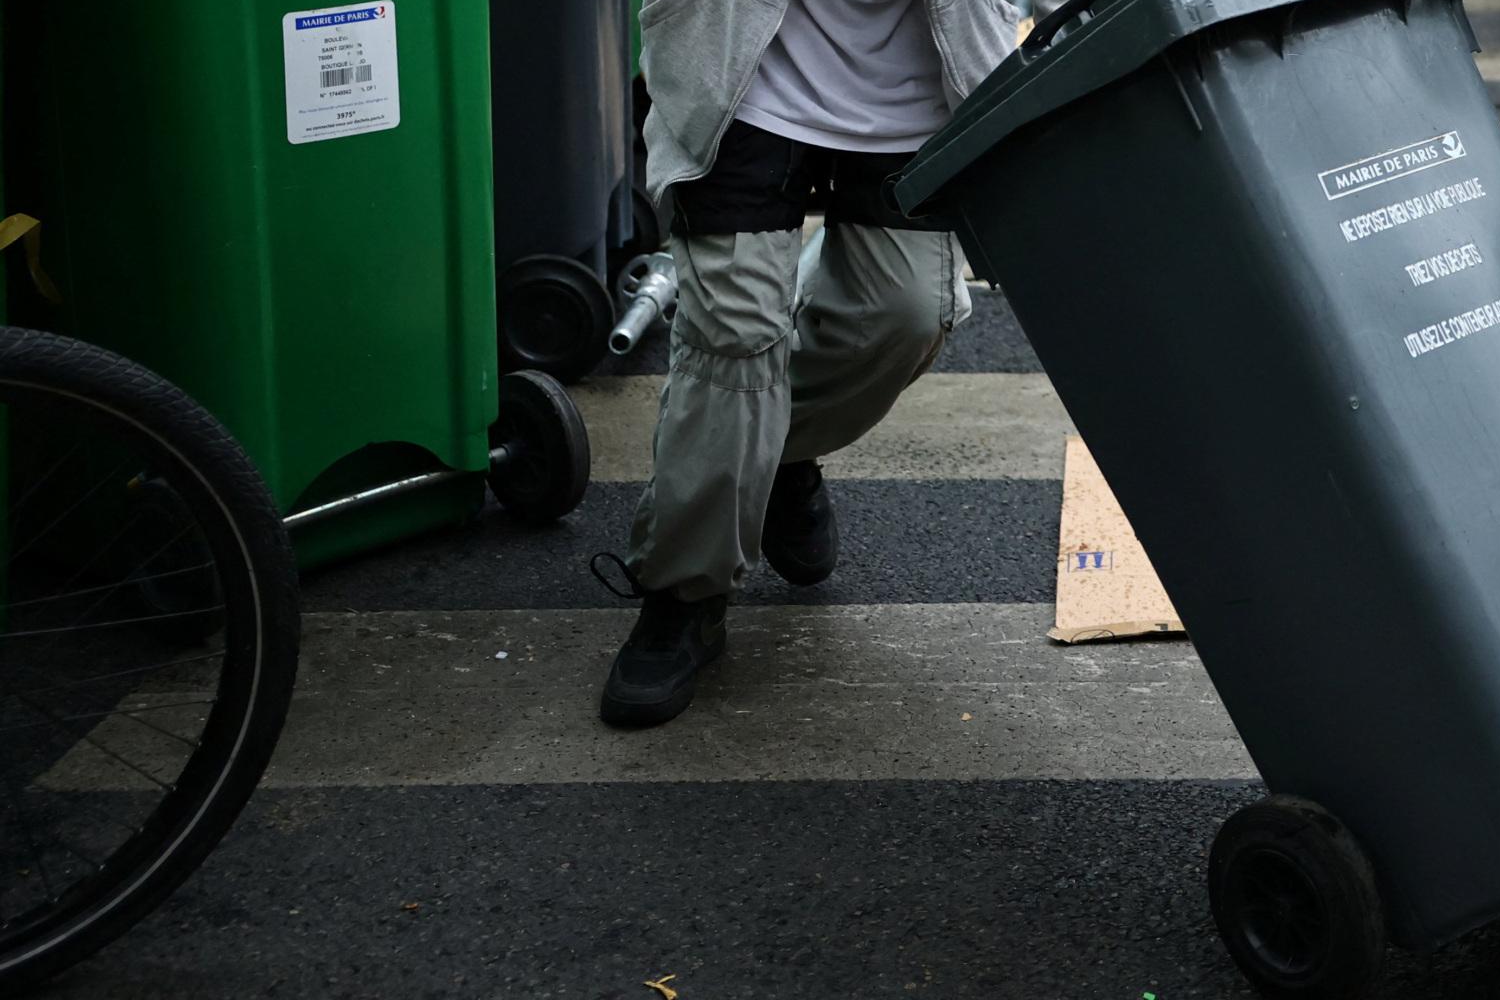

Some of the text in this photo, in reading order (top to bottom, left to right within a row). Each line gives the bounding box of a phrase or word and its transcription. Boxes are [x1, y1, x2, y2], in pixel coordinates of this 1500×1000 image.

[302, 10, 369, 28] MAIRIE DE PARIS
[1335, 145, 1438, 189] MAIRIE DE PARIS
[1339, 218, 1358, 242] NE
[1353, 209, 1393, 238] DEPOSEZ
[1388, 203, 1410, 226] RIEN
[1406, 197, 1425, 219] SUR
[1431, 188, 1454, 210] VOIE
[1448, 177, 1487, 204] PUBLIQUE
[1404, 243, 1483, 287] TRIEZ VOS DECHETS
[1403, 325, 1445, 358] UTILISEZ
[1437, 319, 1456, 344] LE
[1448, 304, 1497, 340] CONTENEUR
